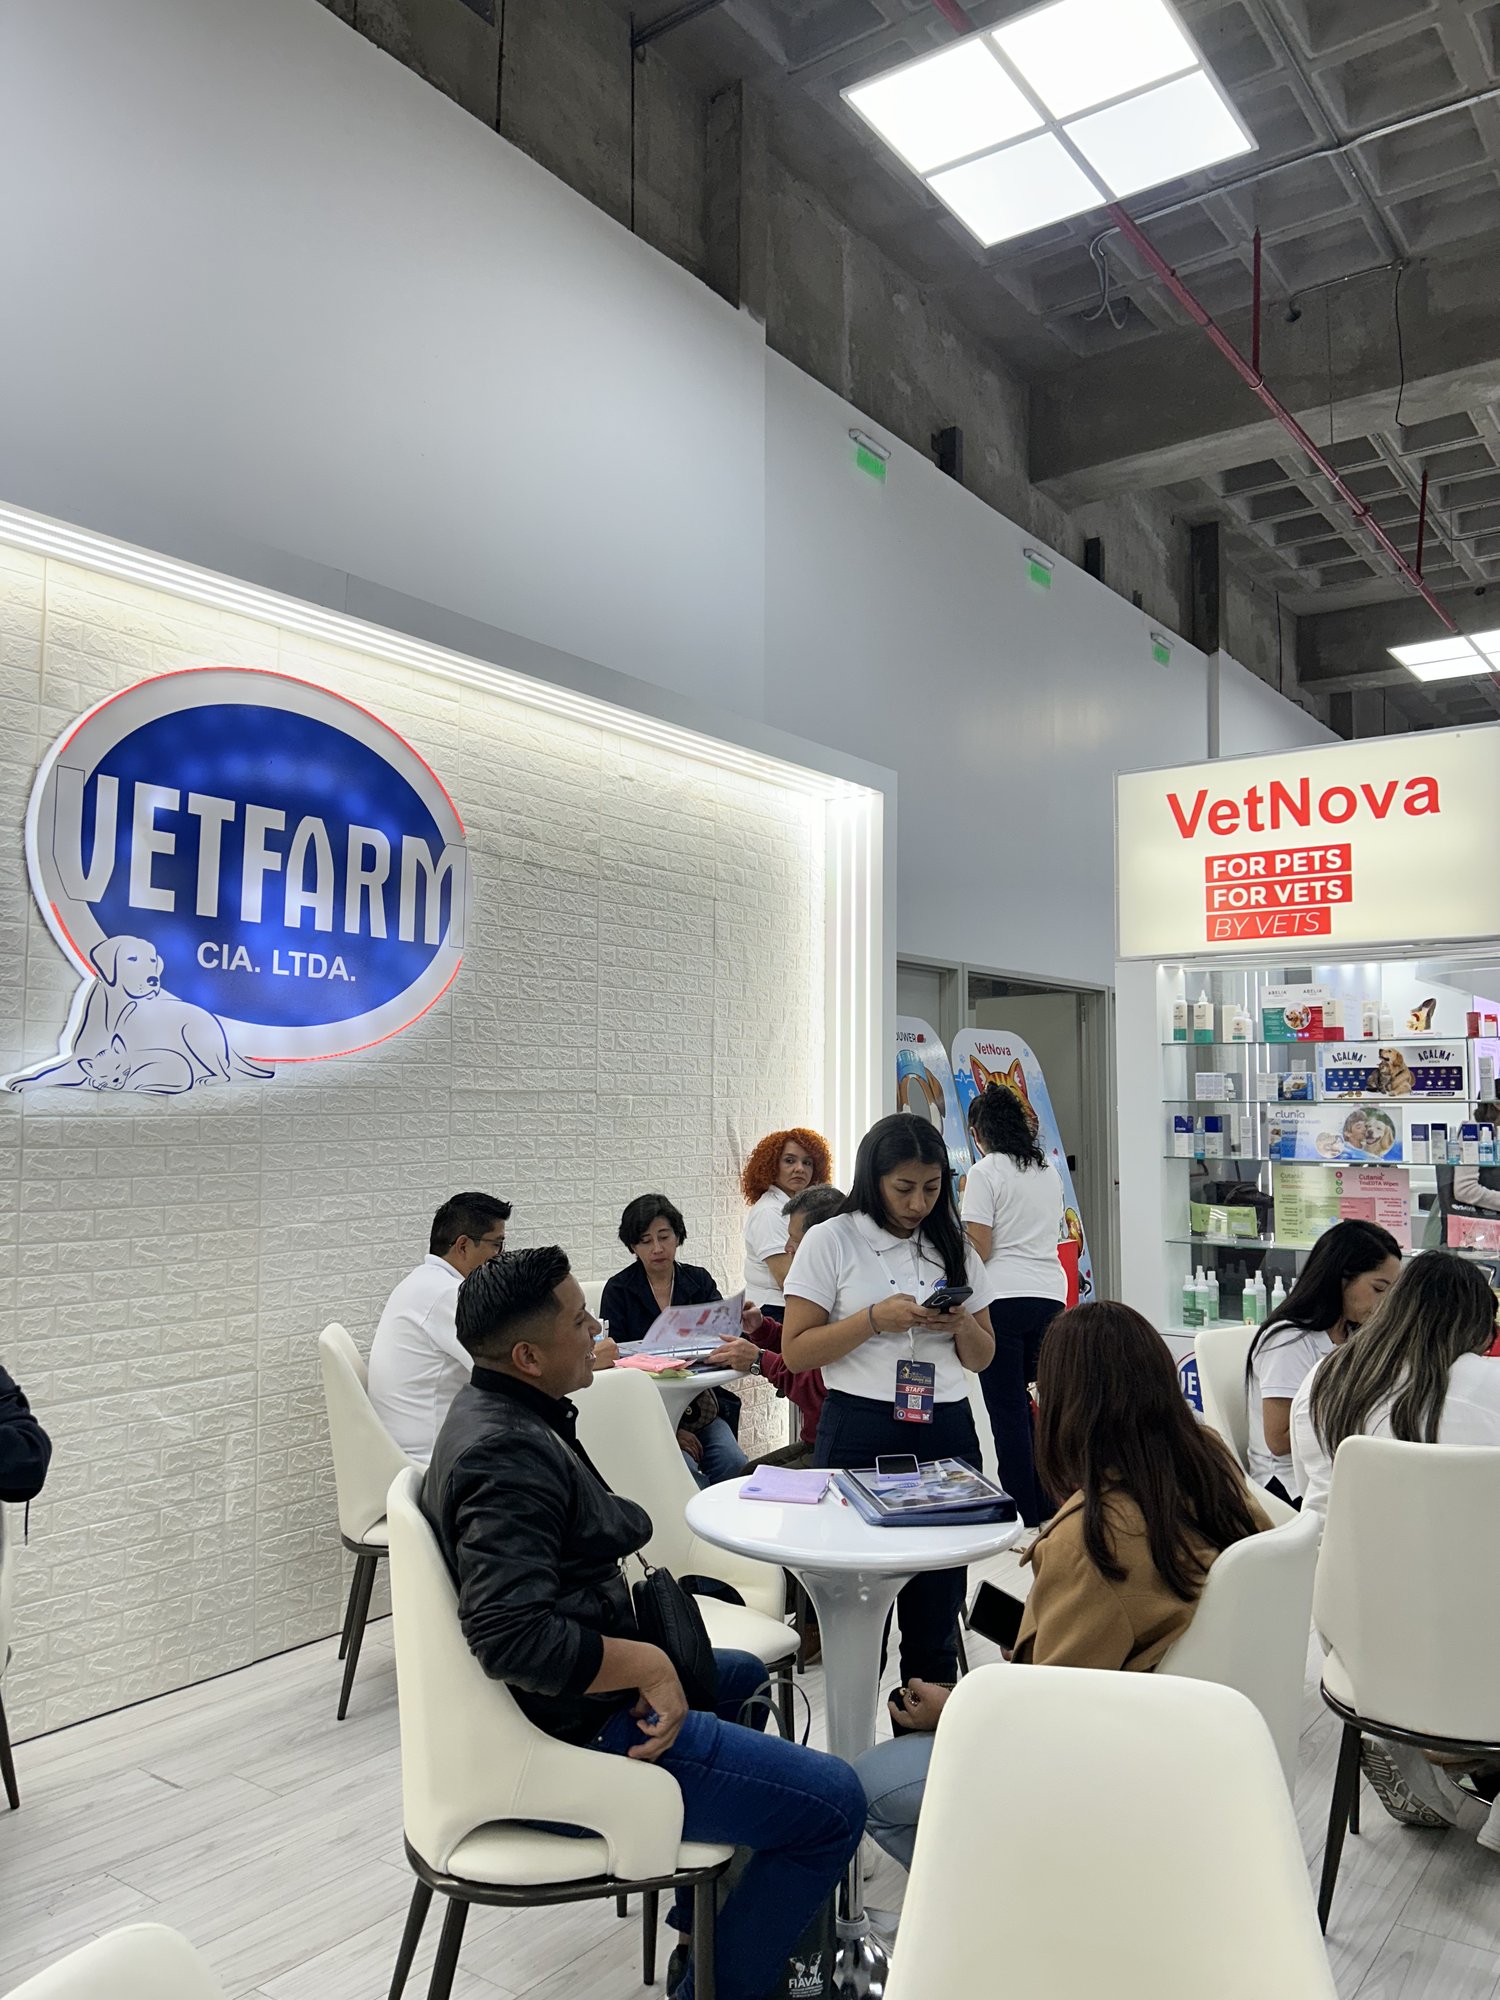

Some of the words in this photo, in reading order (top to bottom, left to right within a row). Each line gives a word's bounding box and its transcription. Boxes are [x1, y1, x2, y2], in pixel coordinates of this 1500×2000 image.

[1166, 776, 1441, 839] VetNova
[53, 765, 467, 948] VETFARM
[1212, 855, 1267, 879] FOR
[1275, 849, 1343, 874] PETS
[1213, 885, 1267, 909] FOR
[1274, 879, 1344, 904] VETS
[1214, 917, 1250, 938] BY
[1255, 911, 1321, 935] VETS
[196, 940, 261, 974] CIA.
[271, 950, 357, 982] LTDA.
[975, 1042, 1011, 1056] VetNova
[788, 1972, 823, 1988] FIAVAC
